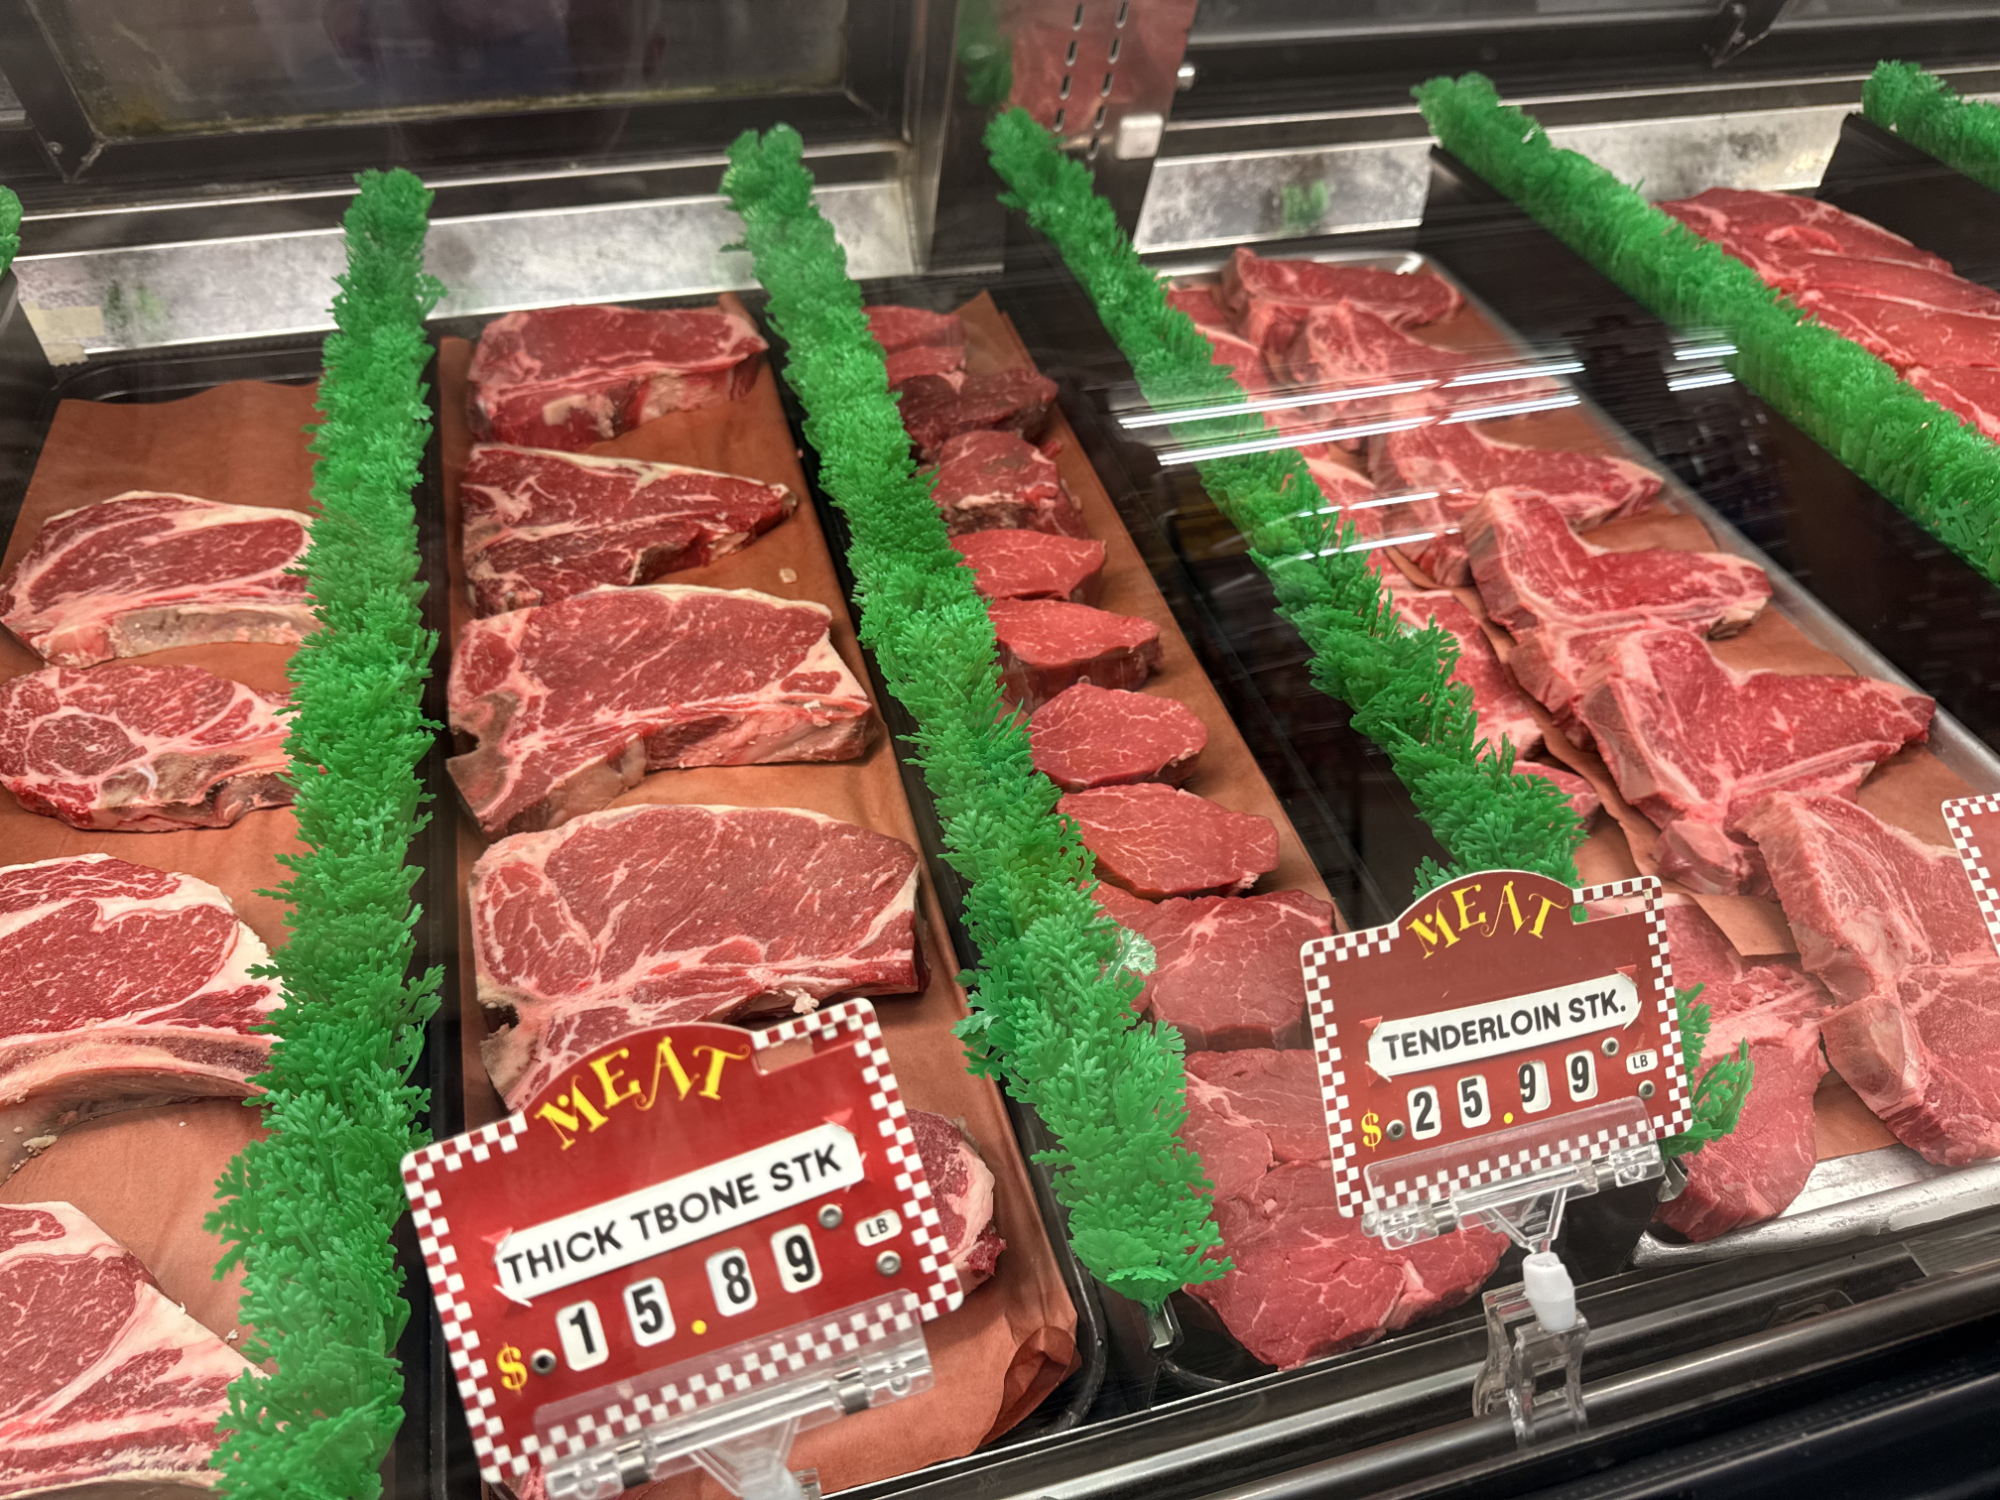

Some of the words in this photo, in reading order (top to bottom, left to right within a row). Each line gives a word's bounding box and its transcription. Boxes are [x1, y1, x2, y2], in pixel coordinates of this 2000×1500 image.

[1406, 880, 1569, 959] MEAT
[1382, 1002, 1561, 1061] TENDERLOIN
[1569, 989, 1626, 1023] STK.
[1633, 1055, 1648, 1069] LB
[535, 1036, 751, 1150] MEAT
[503, 1221, 622, 1285] THICK
[631, 1173, 759, 1242] TBONE
[770, 1143, 843, 1191] STK
[865, 1217, 889, 1239] LB
